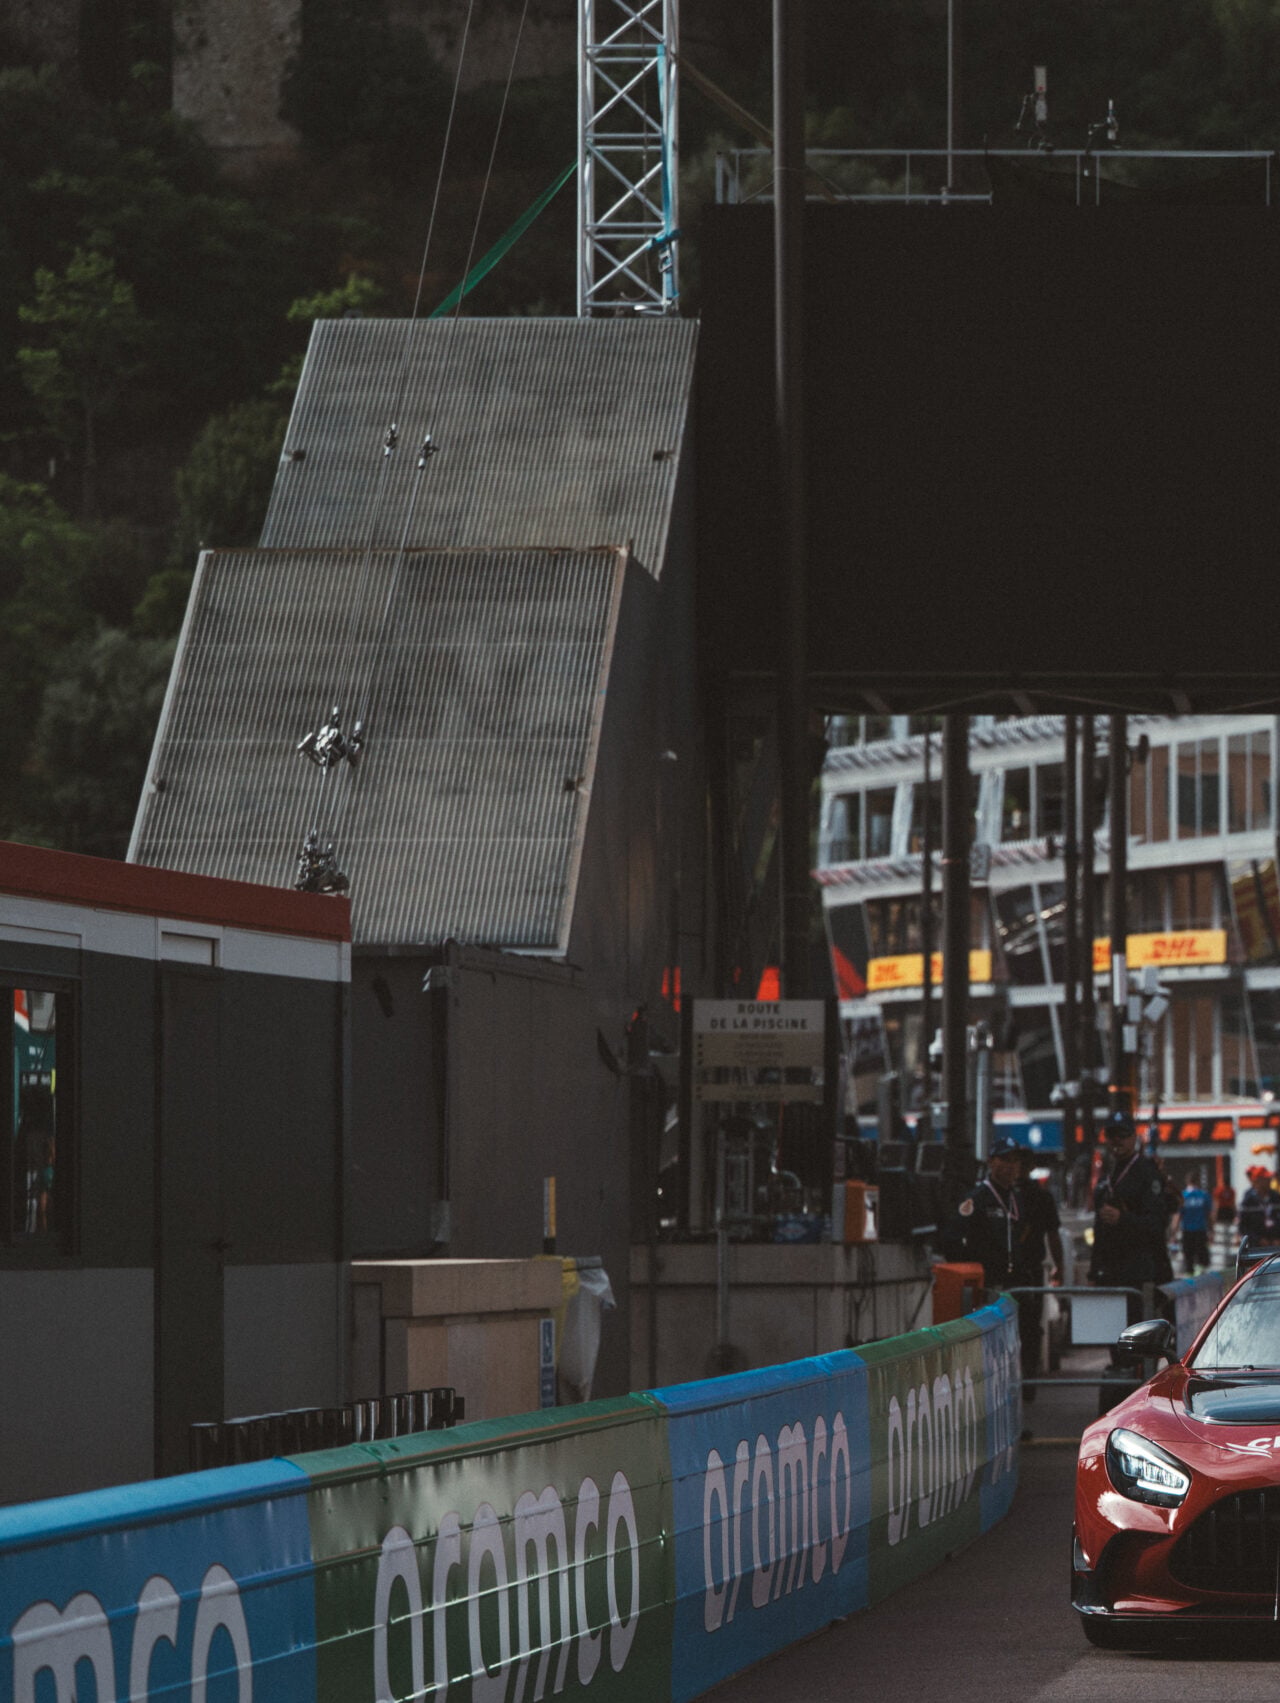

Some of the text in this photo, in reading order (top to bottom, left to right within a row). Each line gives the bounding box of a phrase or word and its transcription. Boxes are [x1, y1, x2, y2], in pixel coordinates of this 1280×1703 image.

[1152, 938, 1199, 958] DHL
[738, 1003, 781, 1014] ROUTE
[710, 1019, 808, 1030] DE LA PISCINE
[704, 1411, 850, 1633] aramco
